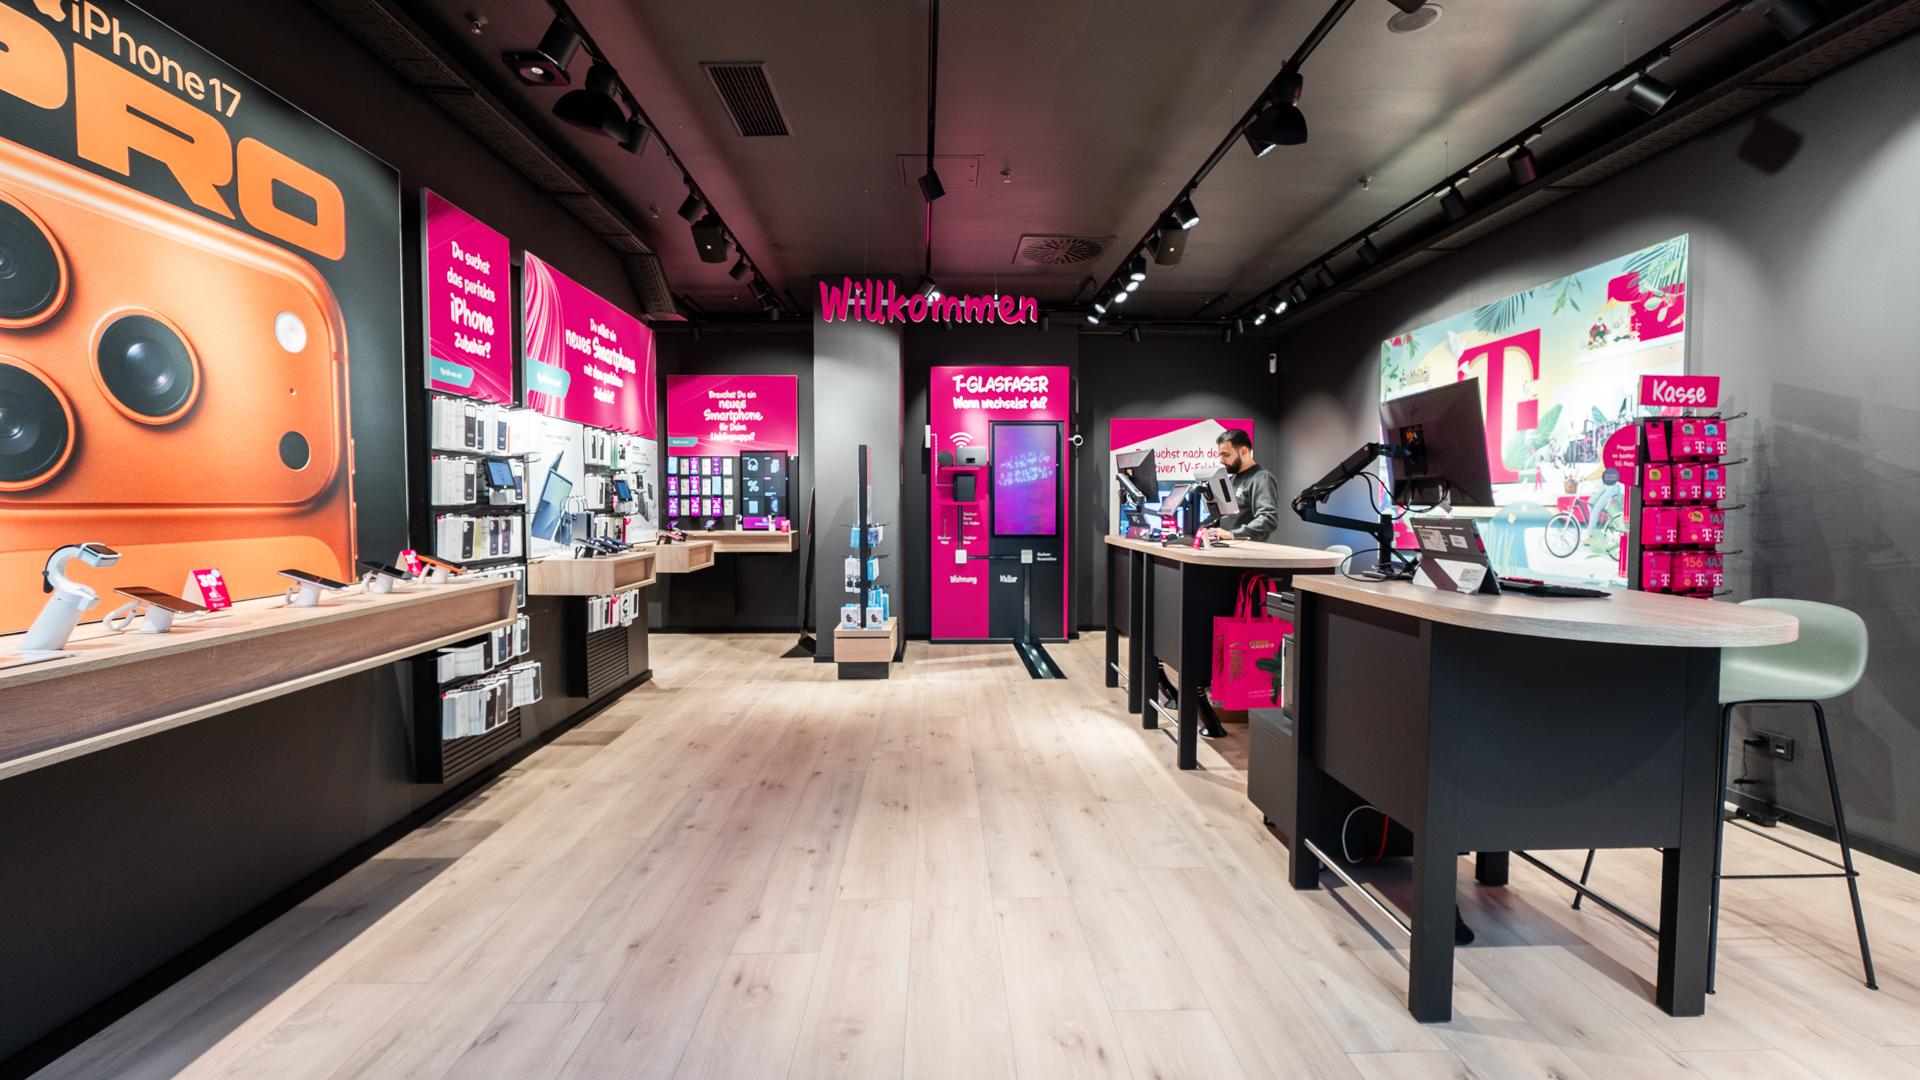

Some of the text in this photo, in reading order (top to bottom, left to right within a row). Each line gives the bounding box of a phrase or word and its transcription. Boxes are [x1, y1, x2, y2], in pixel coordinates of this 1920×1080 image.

[71, 0, 242, 118] iPhone 17
[451, 241, 491, 275] Du suchst
[447, 266, 496, 303] das perfekte
[819, 276, 1038, 325] Willkommen
[450, 292, 495, 336] iPhone
[454, 332, 491, 359] Zubehör?
[565, 329, 636, 374] neues Smartphone
[952, 374, 1049, 393] T-GLASFASER
[708, 389, 757, 399] Brauchst Du ein
[1652, 379, 1707, 404] Kasse
[718, 399, 747, 409] neues
[953, 396, 1048, 410] Wann wechselst du?
[1457, 328, 1541, 485] T
[703, 408, 764, 424] Smartphone
[719, 422, 729, 431] für
[1154, 447, 1220, 459] uchst nach de
[1695, 441, 1705, 454] T
[1716, 441, 1727, 454] T
[1154, 462, 1176, 474] tiven
[1661, 485, 1671, 499] T
[1691, 485, 1701, 499] T
[1716, 485, 1726, 499] T
[1667, 529, 1677, 542] T
[1702, 528, 1712, 541] T
[1714, 529, 1724, 542] T
[1682, 556, 1703, 568] 156
[1661, 573, 1670, 586] T
[1695, 573, 1705, 586] T
[1713, 573, 1722, 586] T
